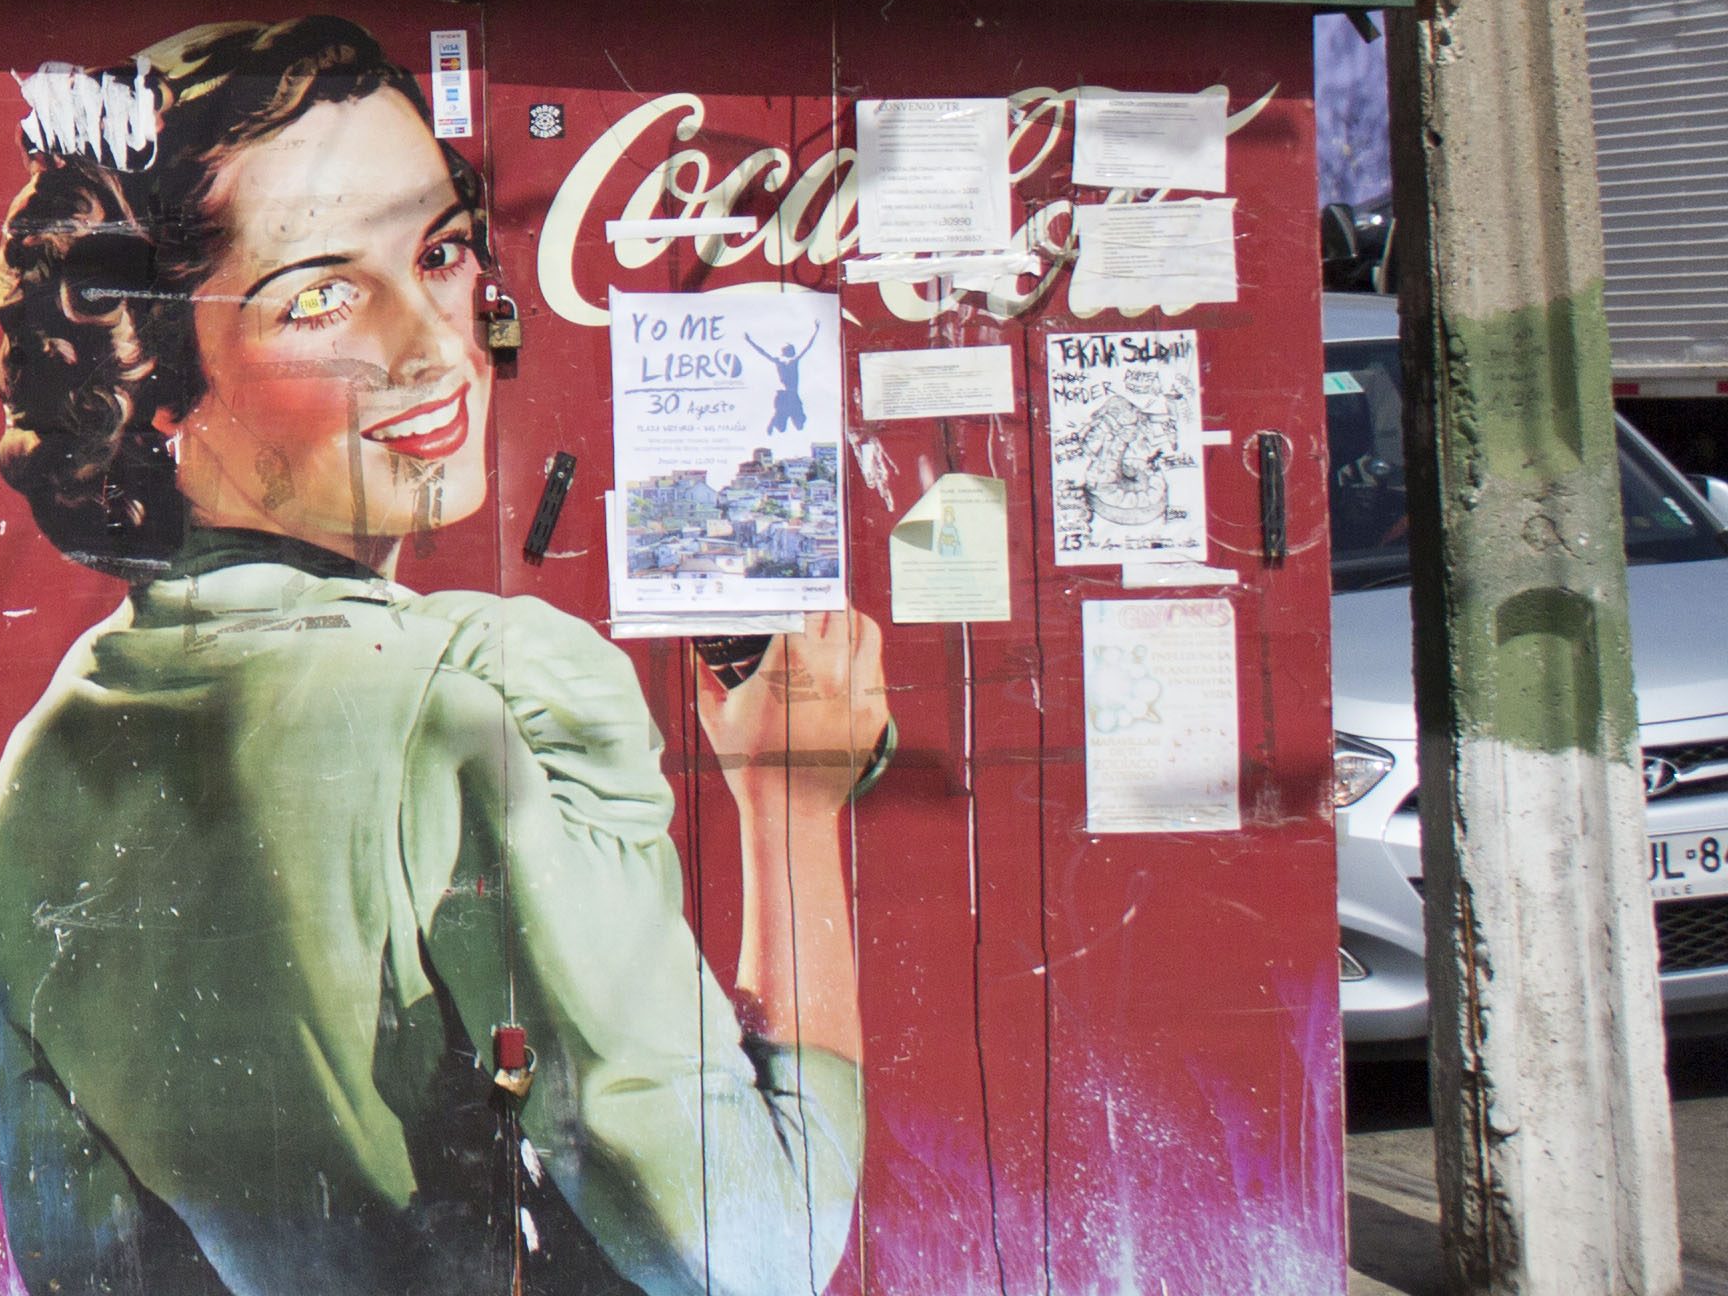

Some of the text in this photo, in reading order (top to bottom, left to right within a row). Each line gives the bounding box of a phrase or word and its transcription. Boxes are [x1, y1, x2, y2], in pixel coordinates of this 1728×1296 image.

[874, 101, 961, 113] CONVENIO VTR
[631, 312, 726, 344] YO ME
[647, 391, 680, 415] 30
